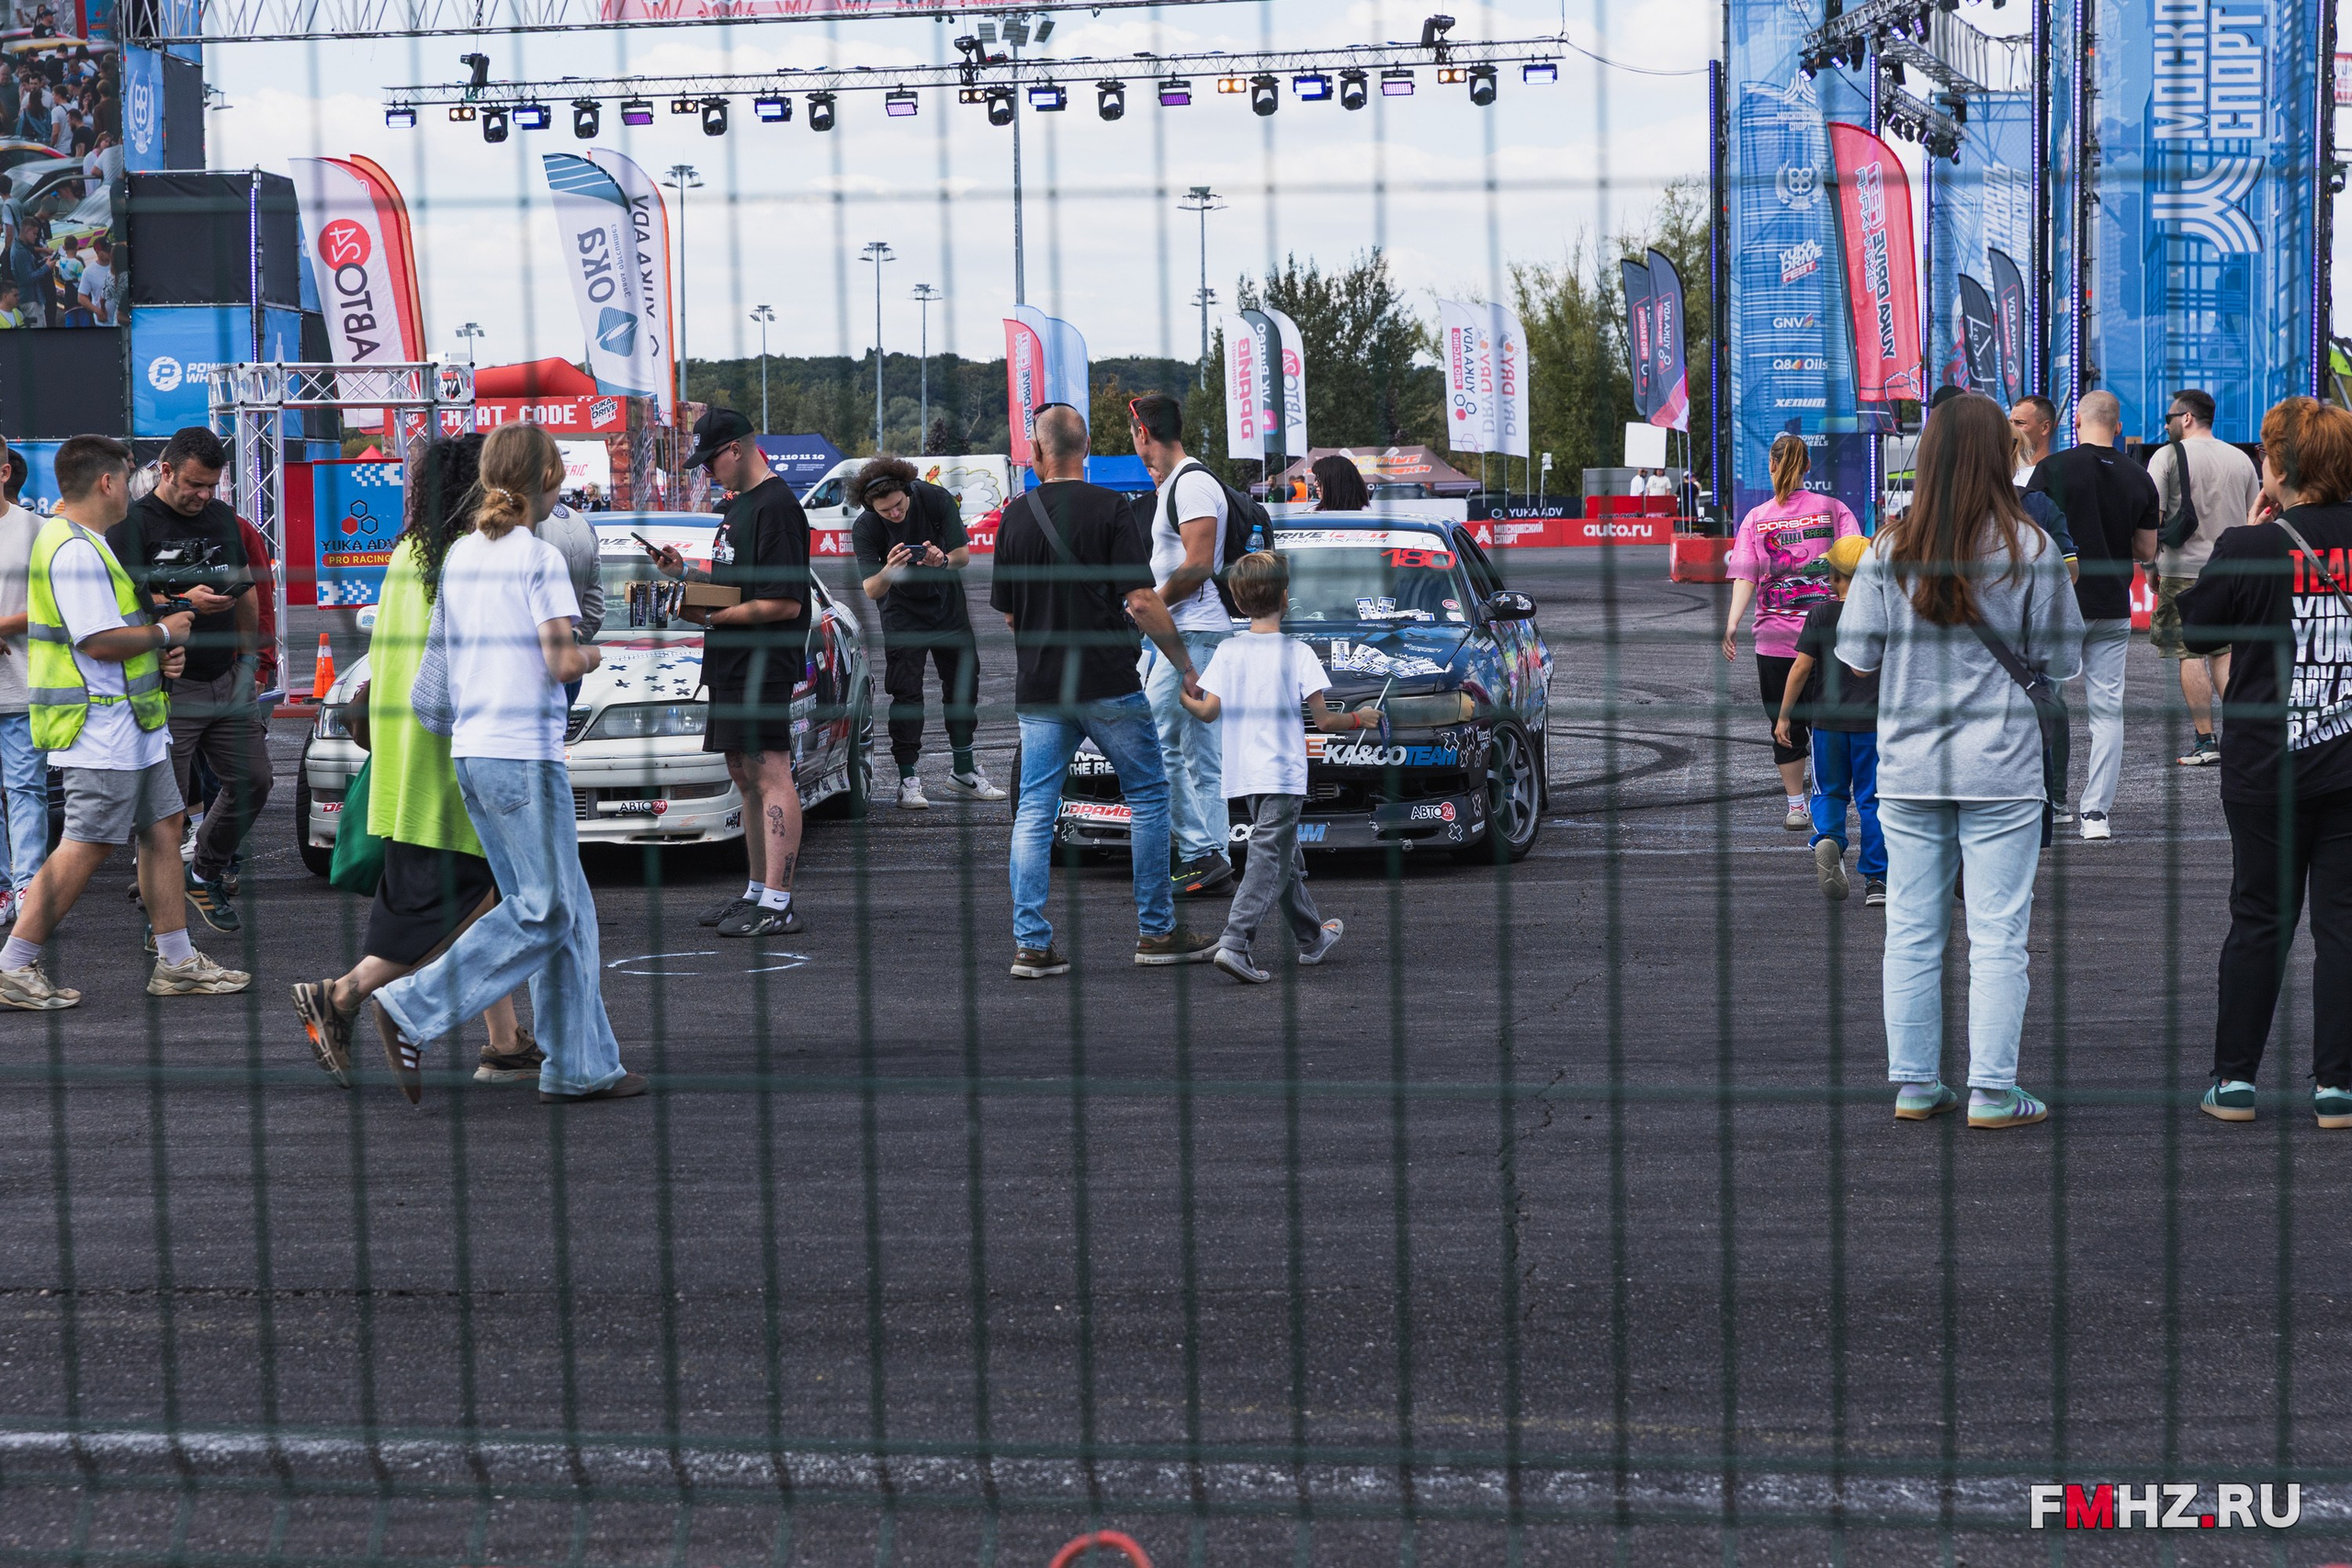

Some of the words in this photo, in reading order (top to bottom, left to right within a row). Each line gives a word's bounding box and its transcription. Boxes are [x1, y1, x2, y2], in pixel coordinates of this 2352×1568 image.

[2211, 7, 2263, 138] СПОРТ
[1776, 109, 1823, 121] МОСКОВСКИЙ
[1789, 122, 1810, 131] СПОРТ
[1778, 239, 1815, 261] YUKA
[1781, 244, 1824, 275] DRIVE
[1772, 317, 1804, 329] GNV
[1772, 359, 1791, 370] Q8
[1804, 358, 1828, 370] Oils
[590, 398, 612, 413] YUKA
[591, 400, 617, 420] DRIVE
[519, 404, 577, 425] CODE
[1509, 507, 1540, 518] YUKA
[1541, 507, 1564, 517] ADV
[1494, 521, 1544, 534] МОСКОВСКИЙ
[1583, 522, 1653, 537] auto.ru
[1756, 514, 1832, 533] PORSCHE
[321, 539, 362, 551] YUKA
[1494, 534, 1518, 545] СПОРТ
[329, 556, 350, 564] PRO
[353, 554, 390, 564] RACING
[1380, 548, 1457, 570] 180
[2288, 547, 2352, 593] TEA
[1069, 761, 1091, 775] THE
[619, 799, 668, 815] АВТО24
[1411, 802, 1455, 820] АВТО24
